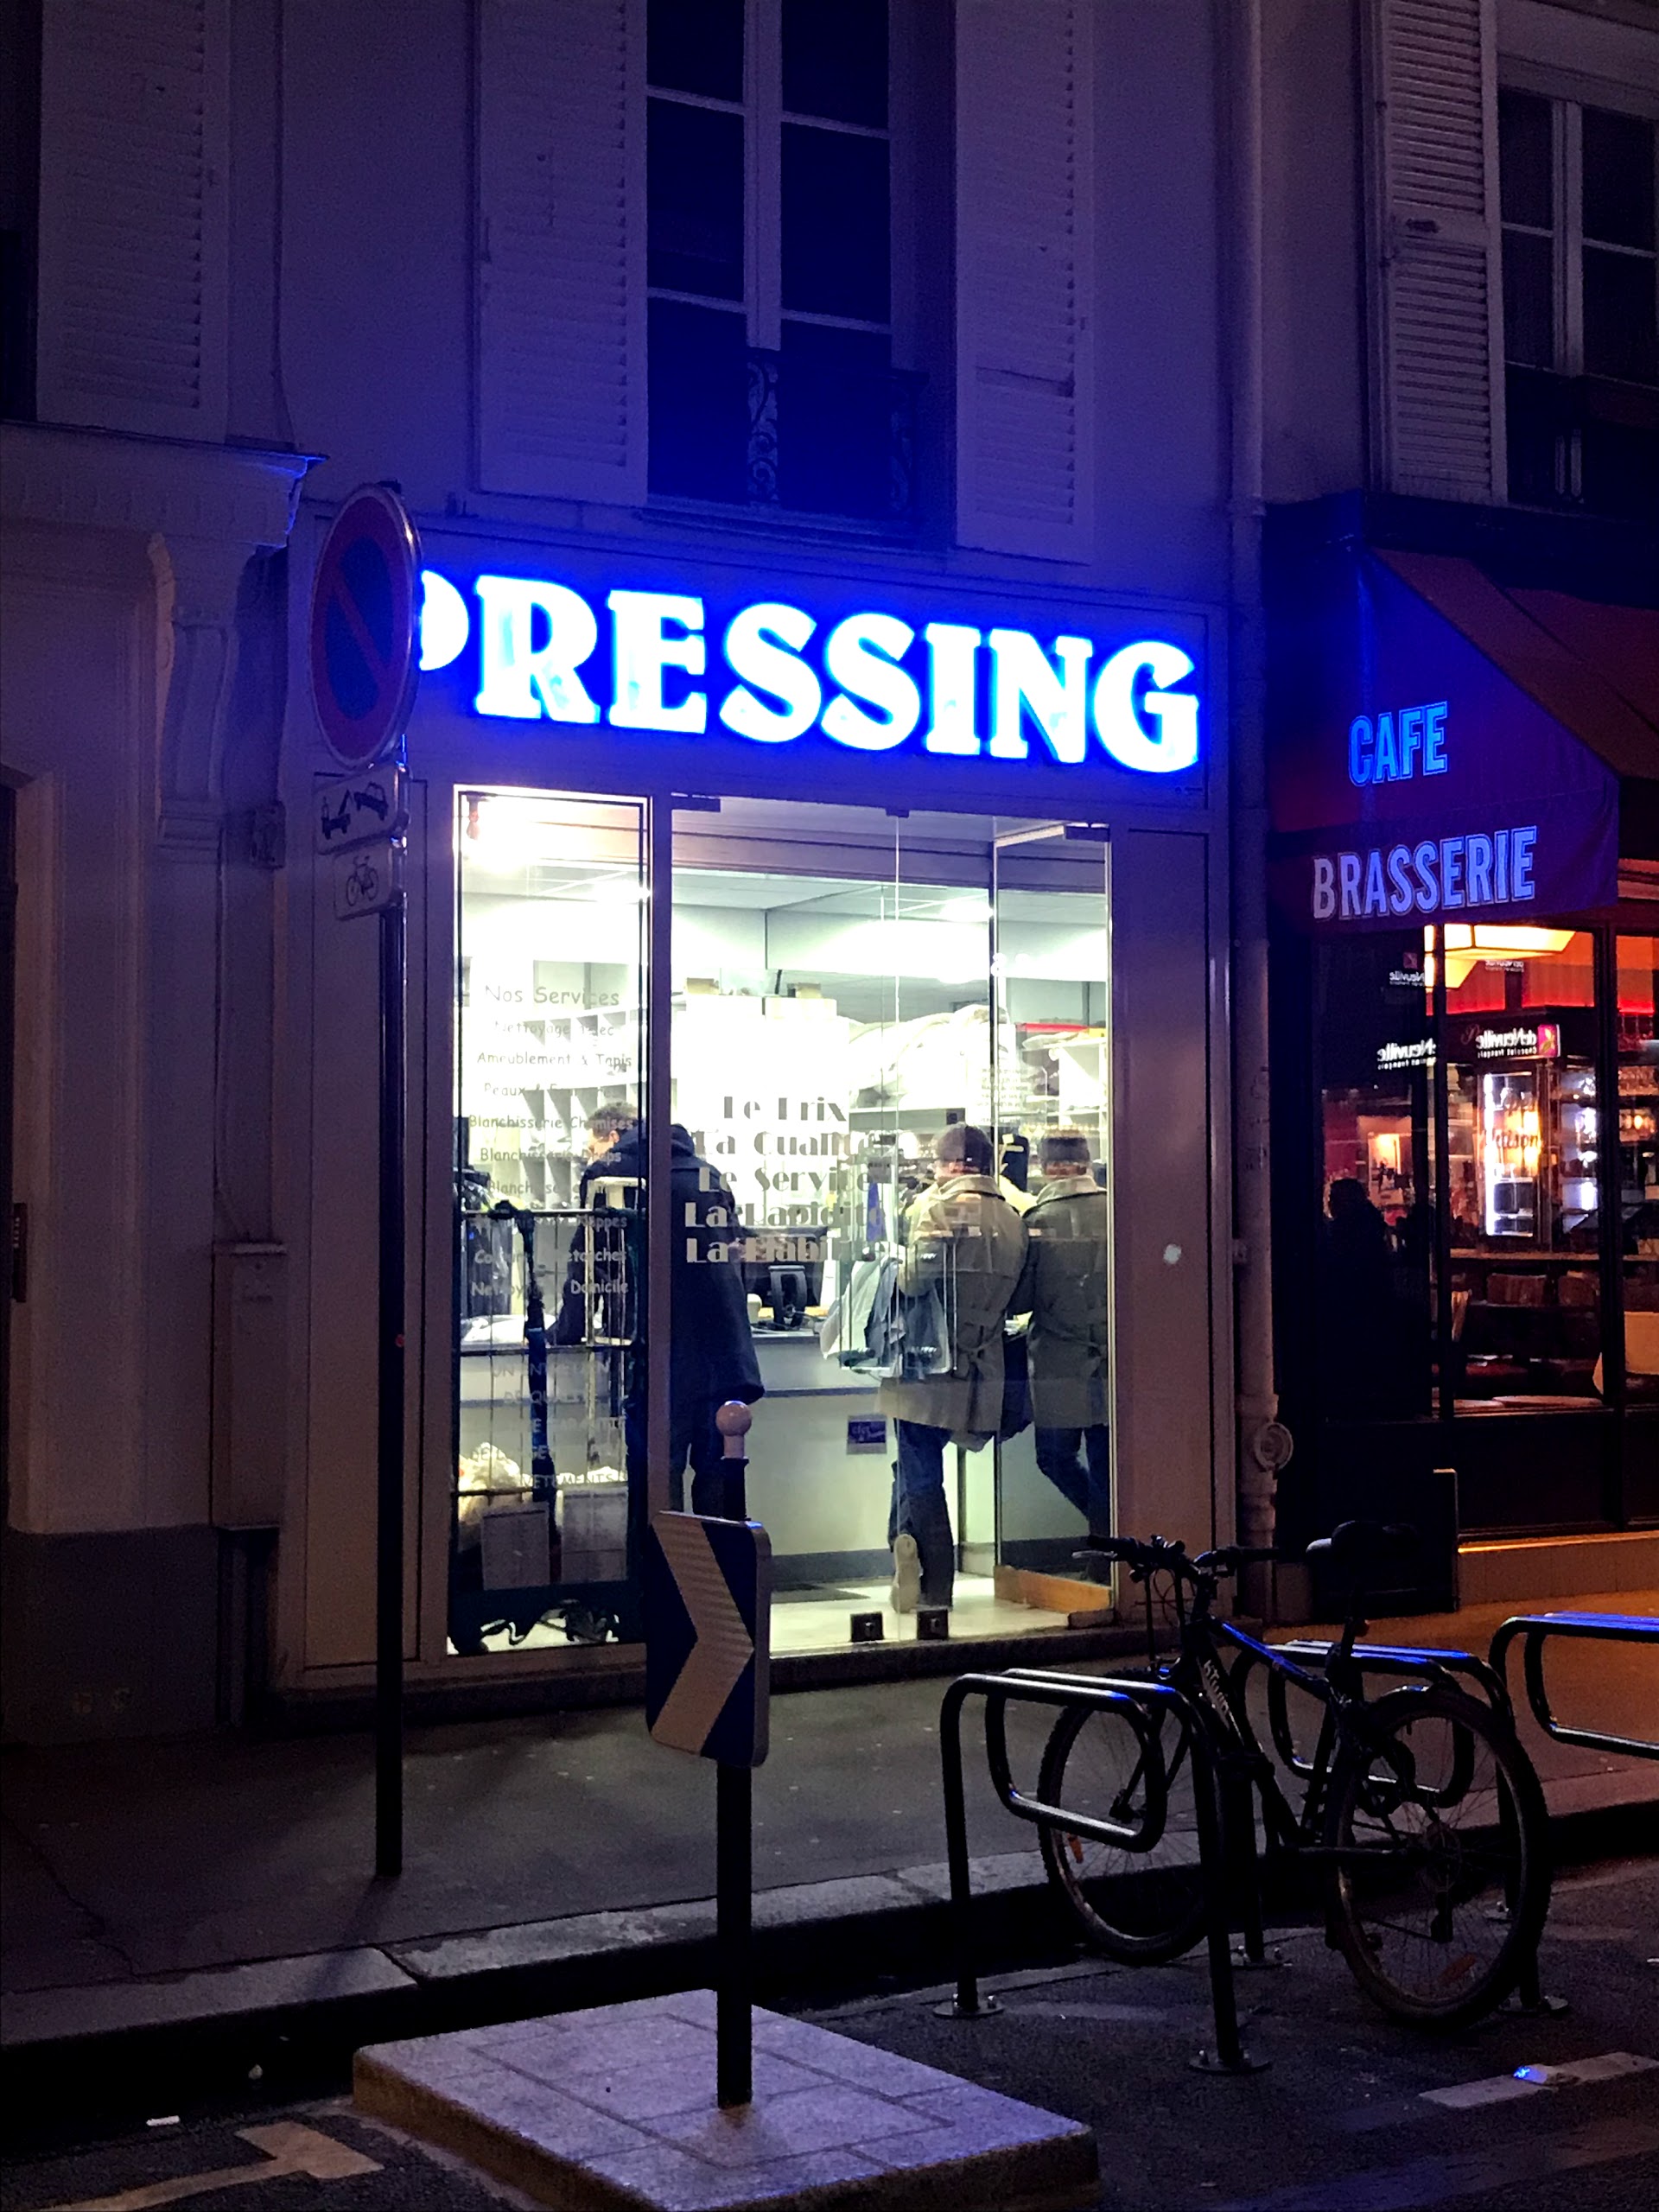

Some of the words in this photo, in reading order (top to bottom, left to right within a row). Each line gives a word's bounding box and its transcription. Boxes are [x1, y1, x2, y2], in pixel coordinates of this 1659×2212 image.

[1348, 701, 1448, 787] CAFE
[1312, 824, 1538, 921] BRASSERIE
[486, 985, 523, 1002] Nos
[534, 986, 620, 1006] Services
[477, 1052, 570, 1065] Ameublement
[596, 1053, 632, 1072] Tapis
[485, 1083, 525, 1096] Peaux
[699, 1166, 737, 1192] Le
[754, 1166, 871, 1192] Service
[685, 1202, 728, 1228] La
[686, 1237, 728, 1263] La
